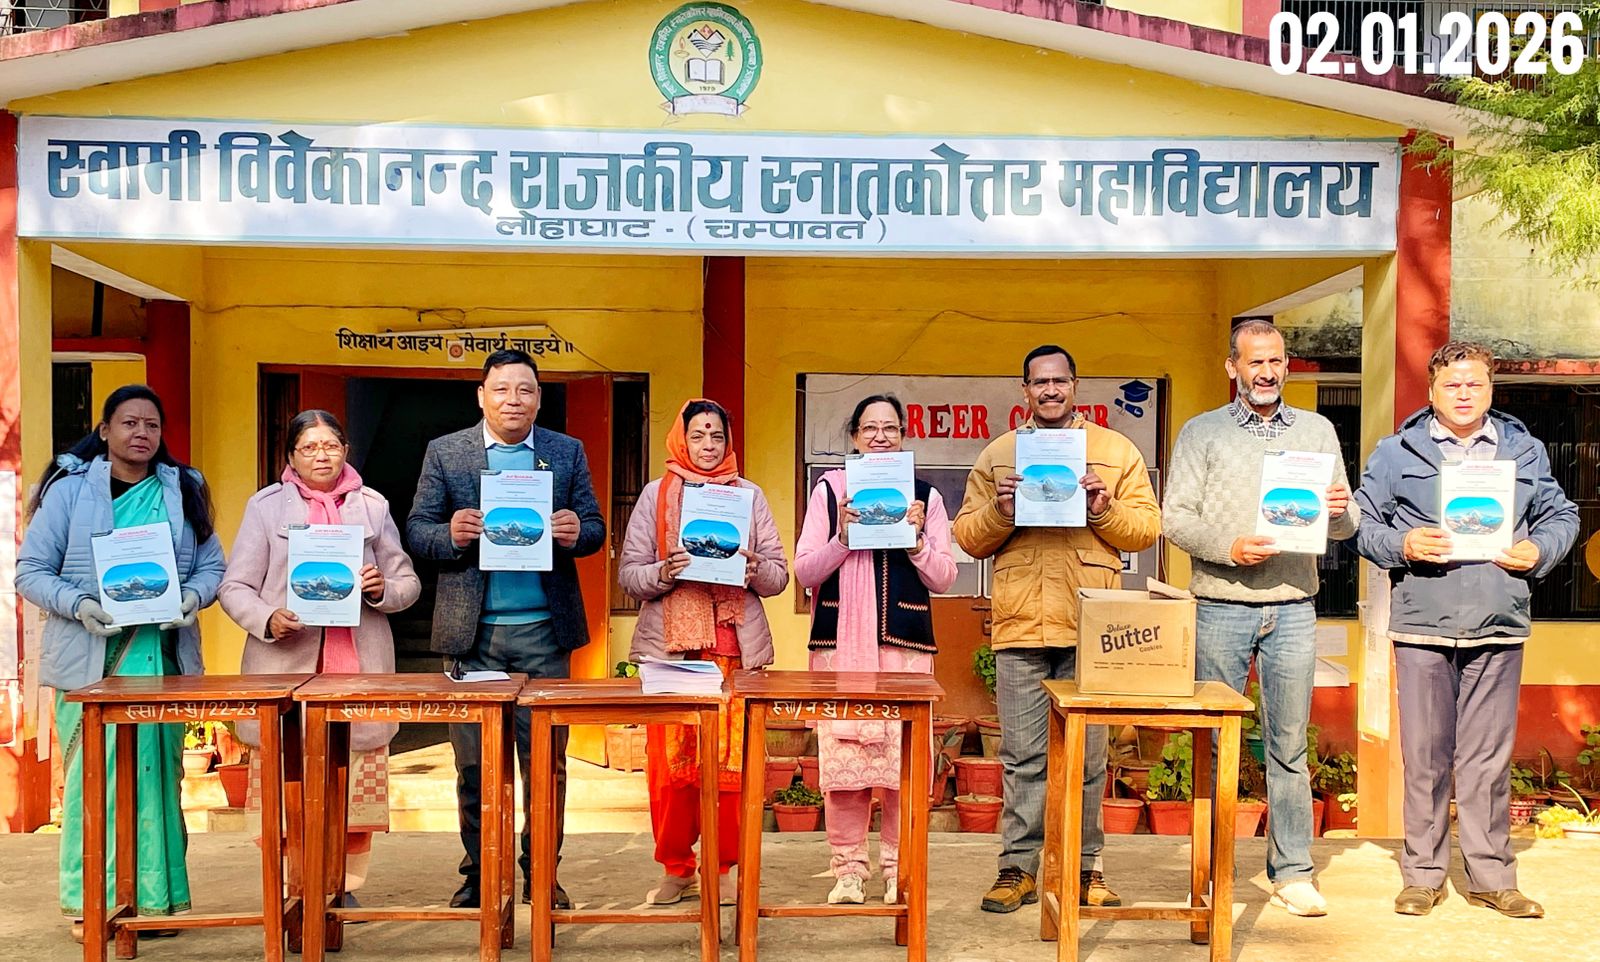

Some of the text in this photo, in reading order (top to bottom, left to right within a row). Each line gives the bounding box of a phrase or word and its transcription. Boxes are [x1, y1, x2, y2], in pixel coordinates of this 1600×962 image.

[48, 129, 1380, 225] स्वामी विवेकानन्द राजकीय स्नातकोत्तर महाविद्यालय
[495, 211, 656, 240] लोहाघाट
[906, 403, 990, 440] REER
[1100, 625, 1161, 654] Butter
[1106, 623, 1132, 634] Deluxe
[1139, 644, 1164, 653] Cookies
